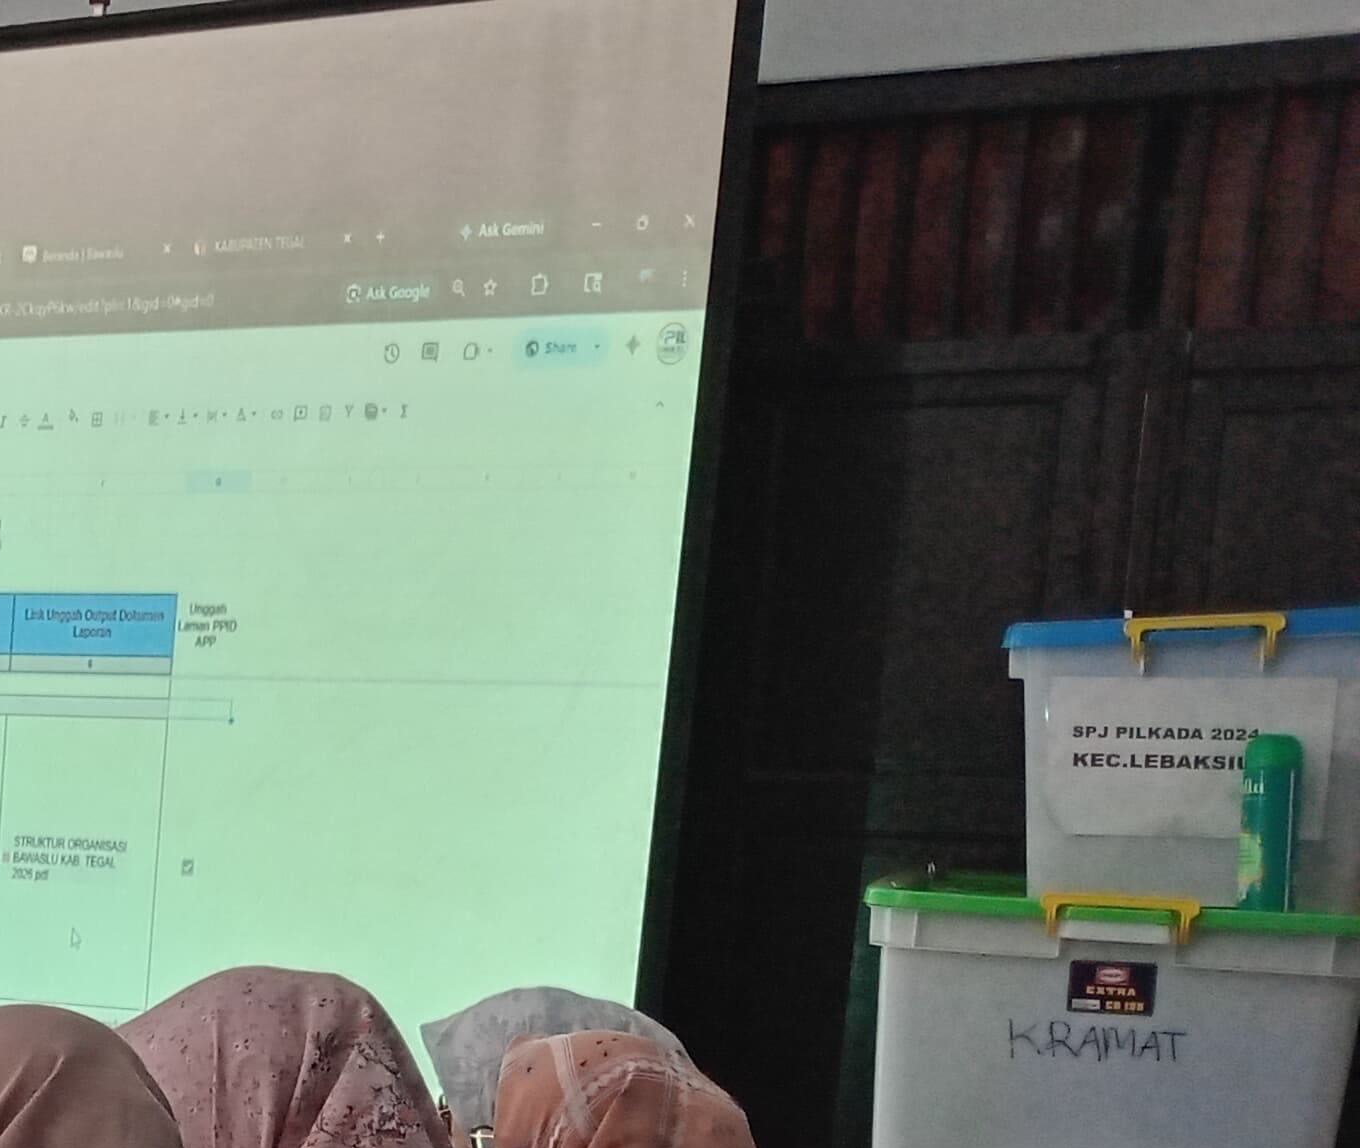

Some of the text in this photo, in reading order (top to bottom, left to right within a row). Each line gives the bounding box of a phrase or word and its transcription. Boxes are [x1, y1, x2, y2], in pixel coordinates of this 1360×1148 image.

[479, 220, 544, 238] Ask Gemini
[366, 282, 431, 301] Ask Google
[46, 609, 82, 623] Unggah
[84, 609, 118, 624] Output
[119, 610, 165, 622] Dokumen
[189, 603, 226, 617] Unggah
[73, 626, 111, 641] Laporan
[179, 620, 237, 632] Laman PPID
[195, 636, 216, 648] APP
[1072, 725, 1260, 741] SPJ PILKADA 2024
[14, 836, 128, 852] STRUKTUR ORGANISASI
[12, 851, 116, 869] BAWASLU TEGAL
[1085, 985, 1136, 996] EXTRA
[1009, 1018, 1186, 1062] KRAMAT
